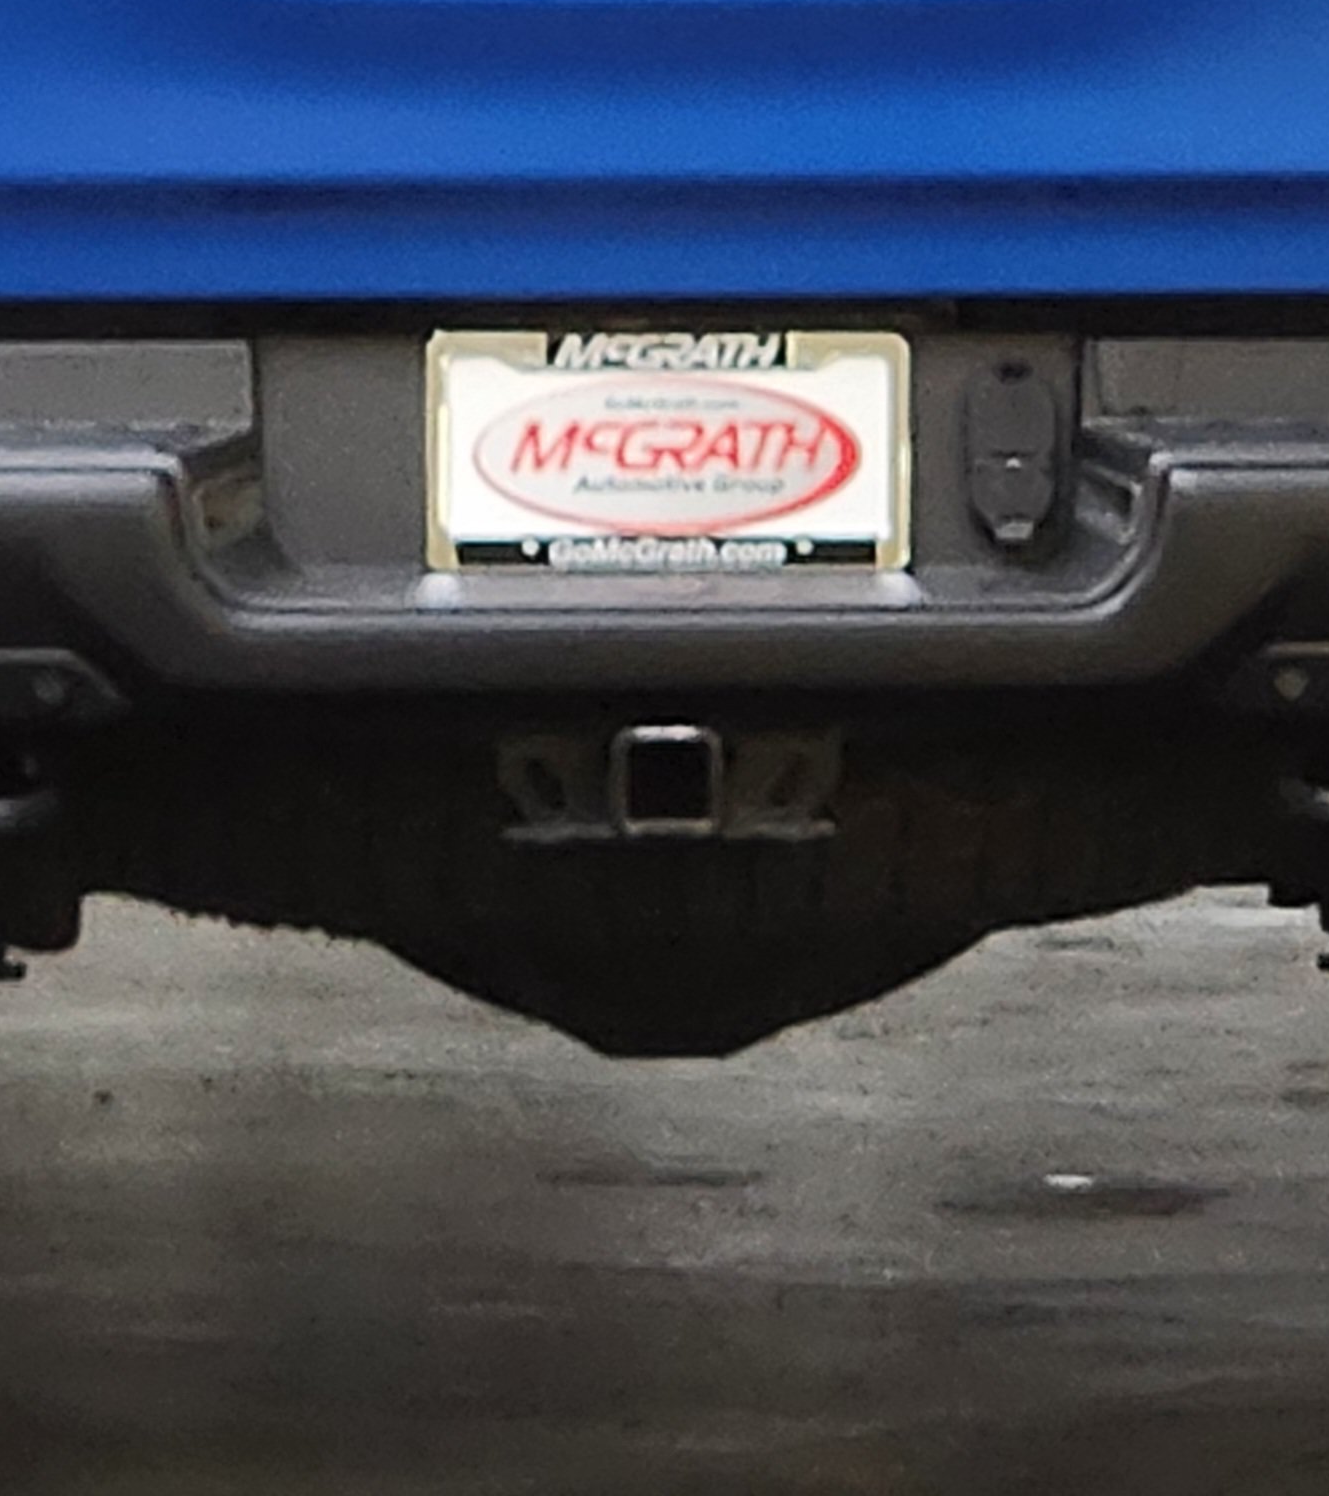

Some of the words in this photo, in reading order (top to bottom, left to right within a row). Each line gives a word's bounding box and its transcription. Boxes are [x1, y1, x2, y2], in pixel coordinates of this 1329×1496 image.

[574, 476, 706, 494] Automotive
[713, 476, 787, 496] Group
[550, 537, 788, 569] GoMcGrath.com
